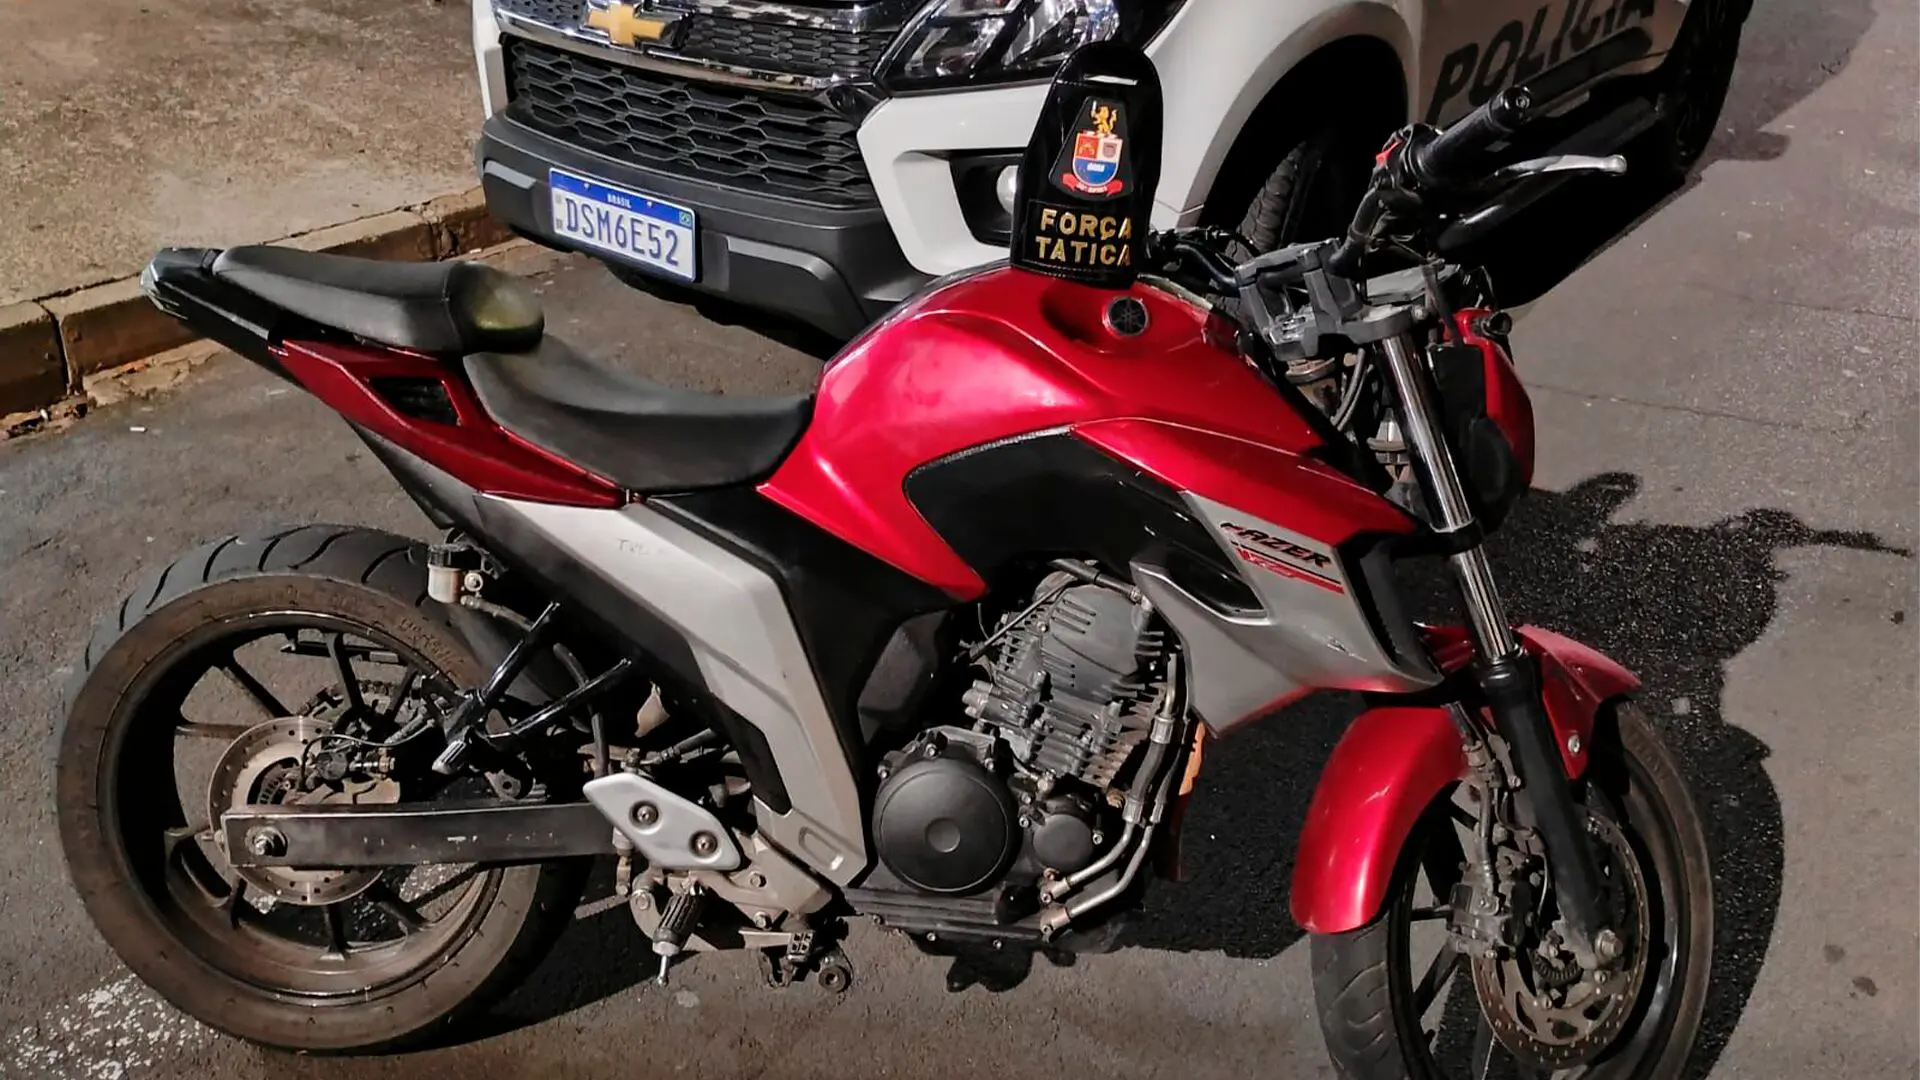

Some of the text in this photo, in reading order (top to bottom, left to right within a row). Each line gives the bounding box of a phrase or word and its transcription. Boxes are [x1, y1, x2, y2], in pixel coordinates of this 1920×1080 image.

[607, 193, 632, 209] BRASIL
[565, 197, 679, 267] DSM6E52
[1040, 208, 1133, 240] FORÇA
[1035, 235, 1131, 267] TATICA
